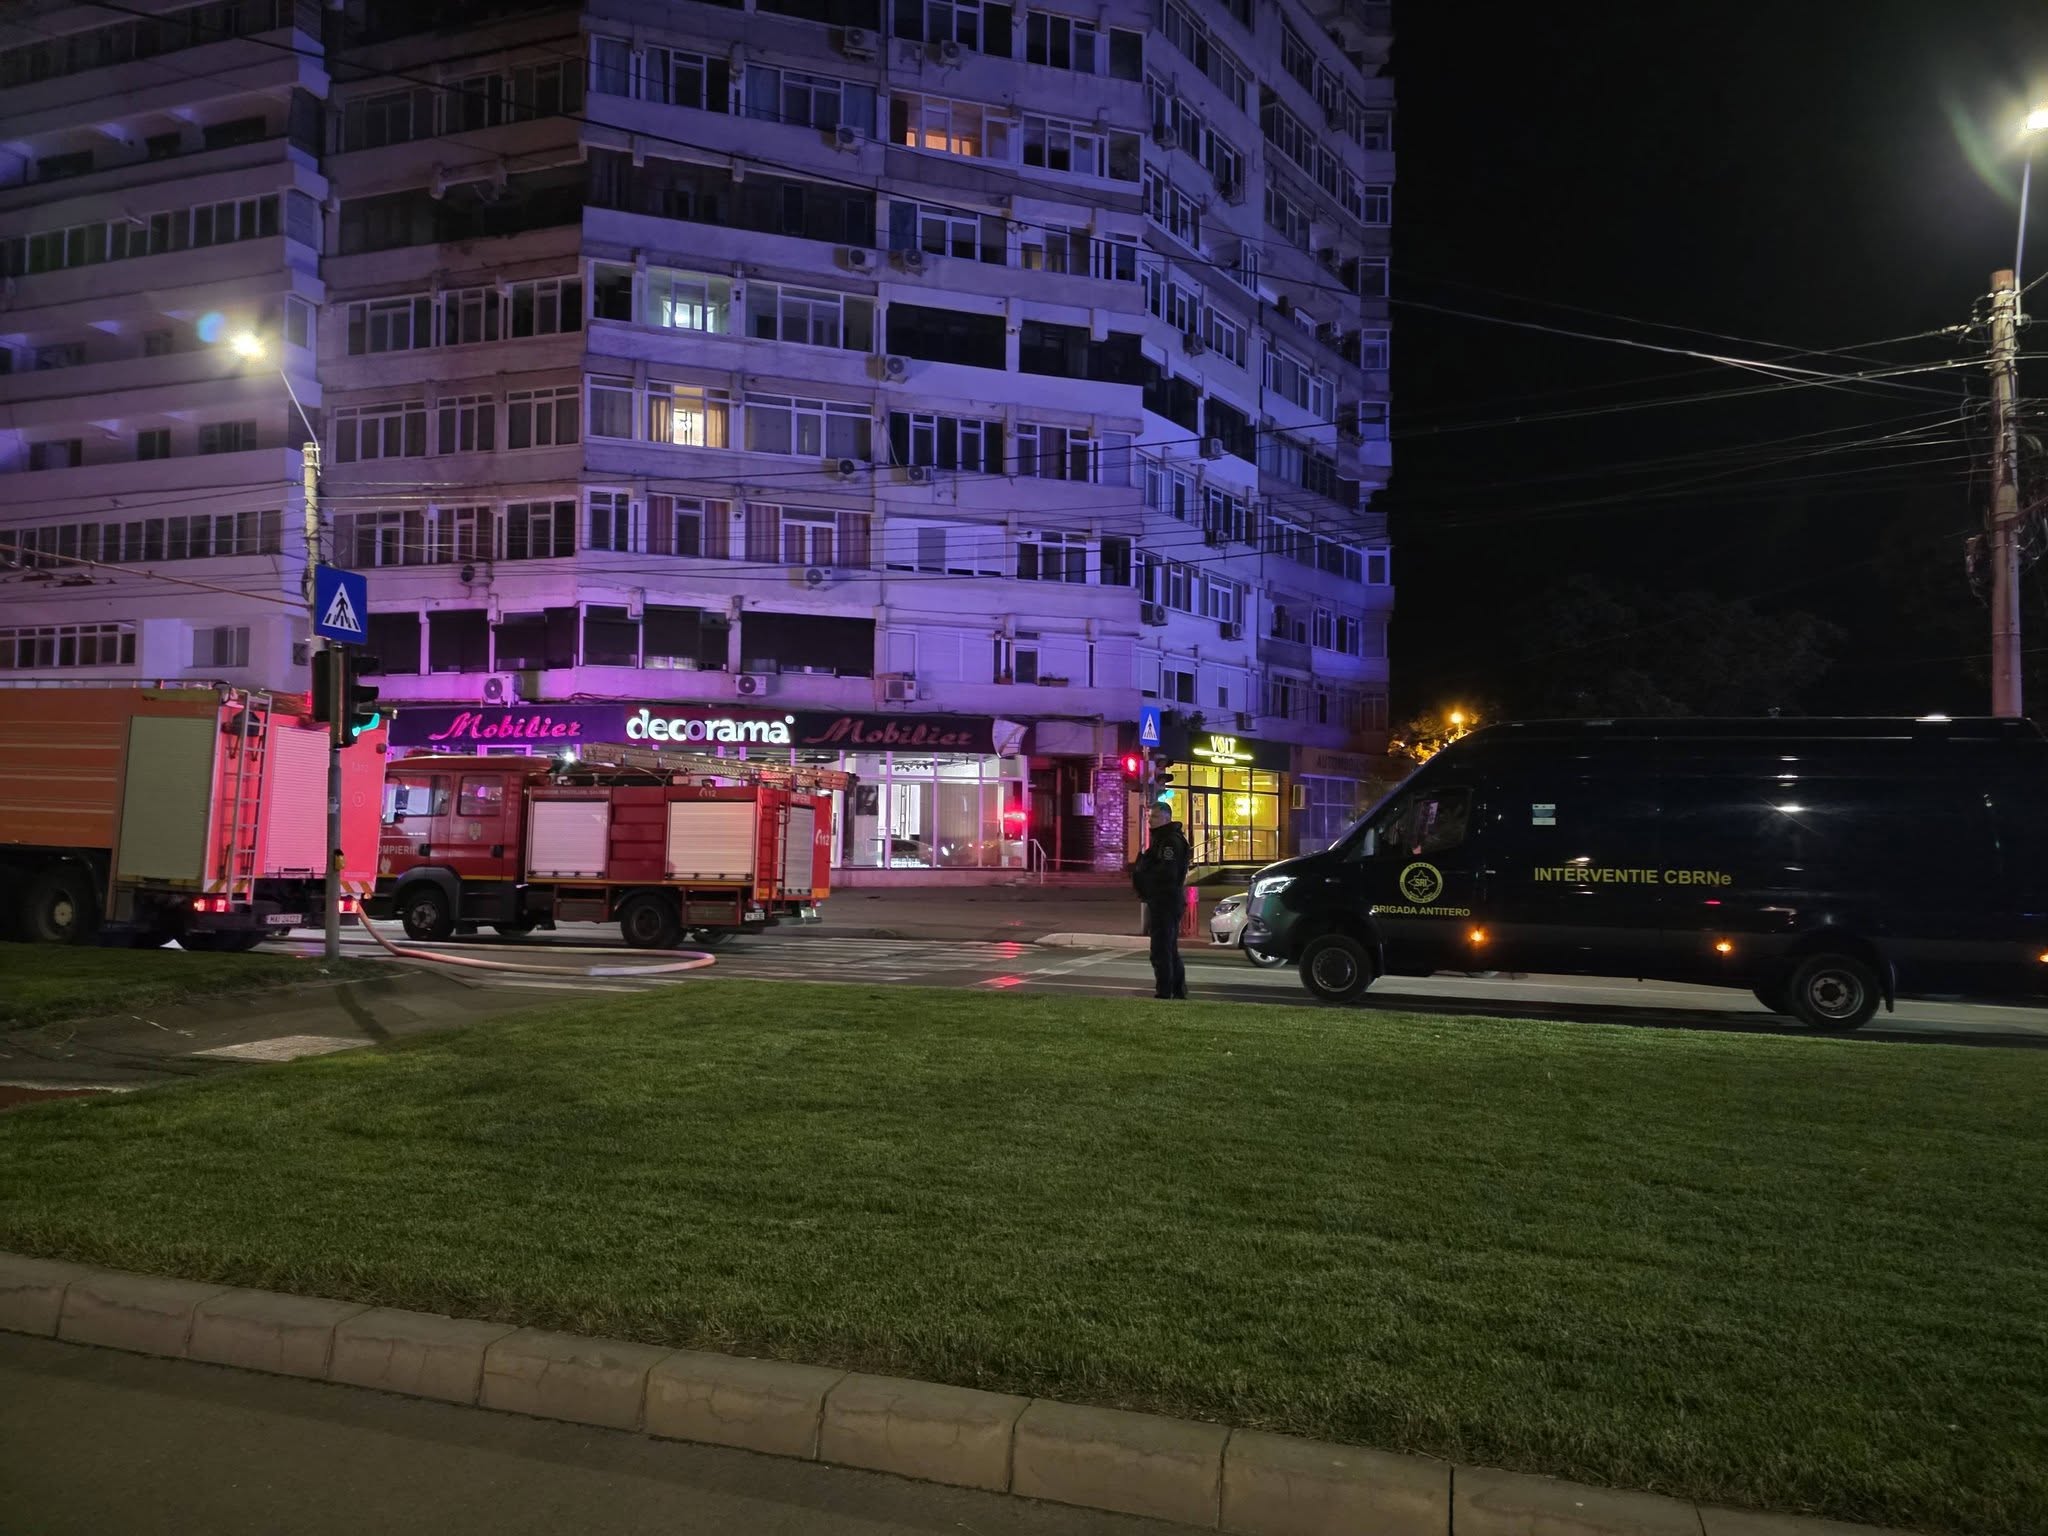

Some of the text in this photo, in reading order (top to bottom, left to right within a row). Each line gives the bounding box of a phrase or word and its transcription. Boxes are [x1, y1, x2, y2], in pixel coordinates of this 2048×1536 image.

[427, 711, 582, 741] Mobilier
[626, 708, 791, 744] decorama
[802, 717, 974, 746] Mobilier
[1210, 735, 1236, 754] VOLT
[704, 789, 717, 798] 112
[819, 834, 830, 846] 112
[379, 845, 415, 856] OMPIERII
[1534, 867, 1732, 886] INTERVENTIE CBRNe
[1372, 904, 1470, 917] BRIGADA ANTITERO
